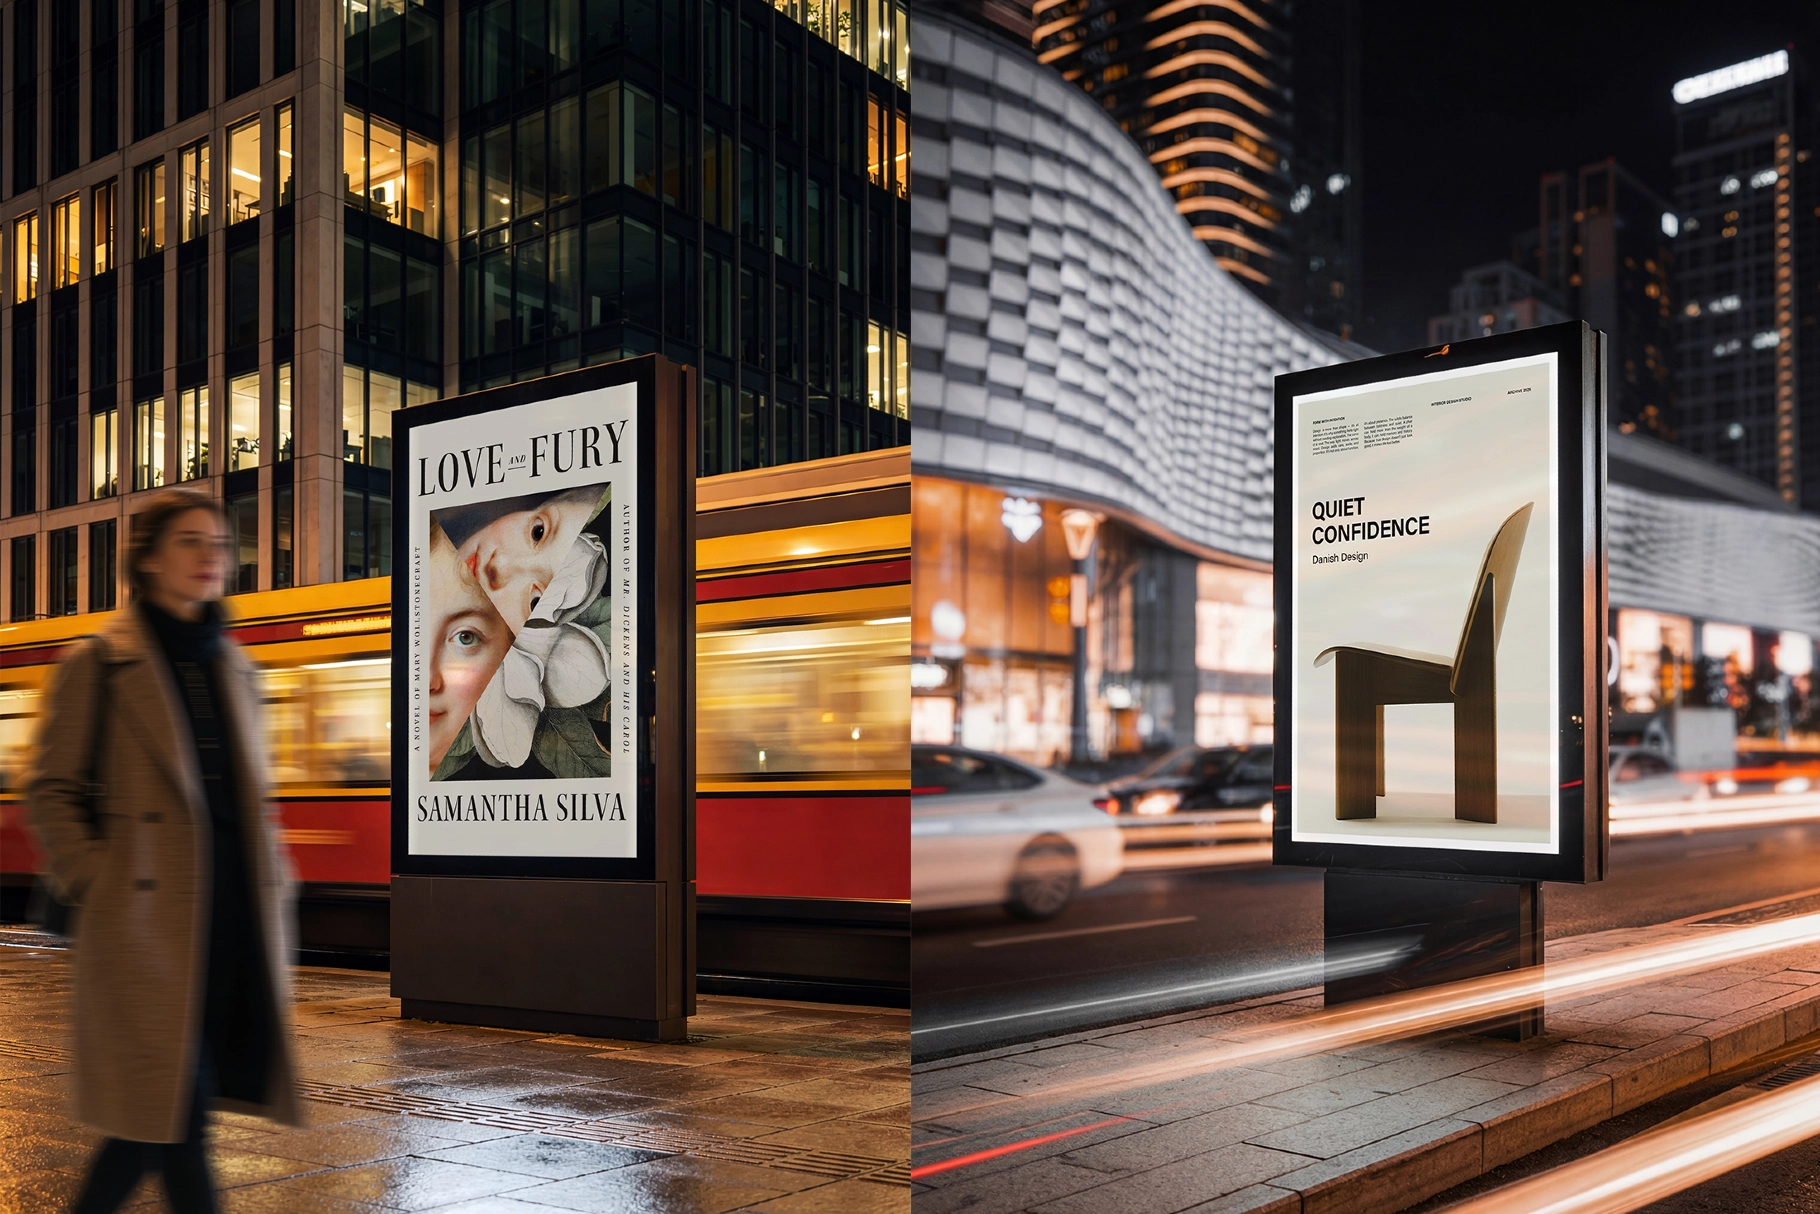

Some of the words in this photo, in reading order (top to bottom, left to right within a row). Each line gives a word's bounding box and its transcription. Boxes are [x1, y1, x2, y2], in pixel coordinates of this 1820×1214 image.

[418, 443, 505, 497] LOVE
[508, 454, 526, 465] AND
[529, 419, 629, 478] FURY
[1312, 497, 1365, 521] QUIET
[1312, 516, 1430, 545] CONFIDENCE
[623, 558, 630, 572] OF
[1312, 553, 1339, 564] Danish
[1341, 551, 1369, 563] Design
[414, 687, 420, 700] OF
[417, 793, 549, 822] SAMANTHA
[556, 792, 627, 822] SILVA
